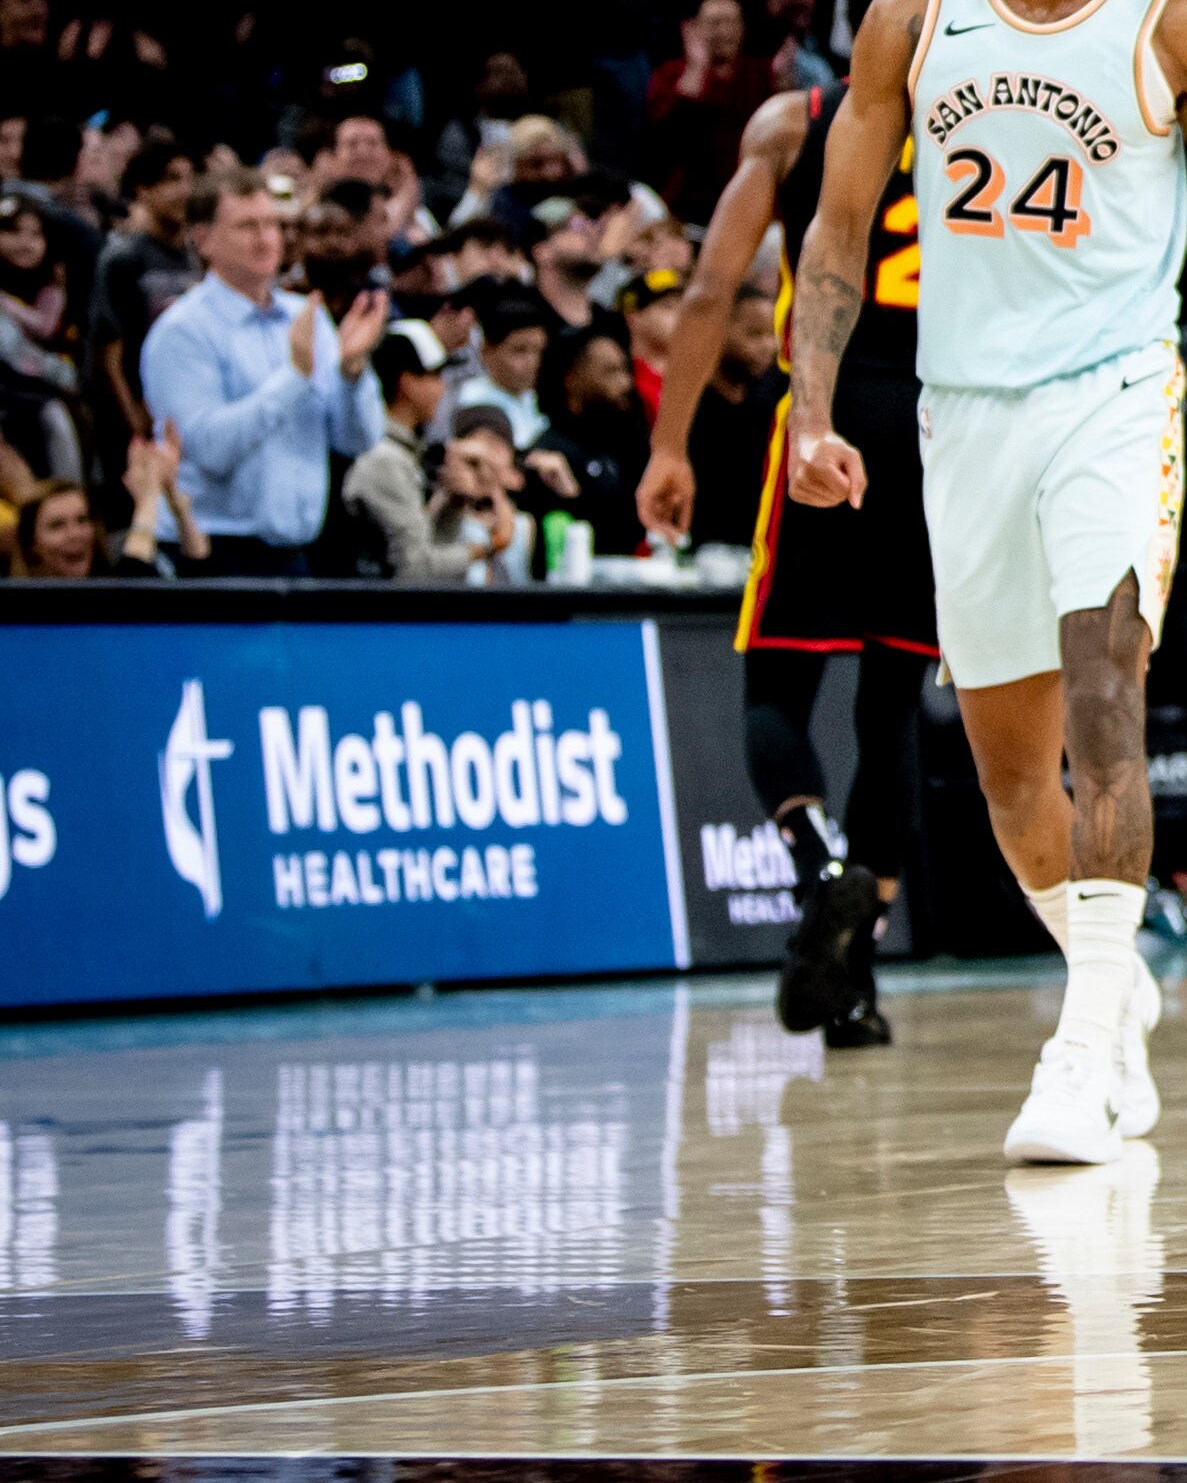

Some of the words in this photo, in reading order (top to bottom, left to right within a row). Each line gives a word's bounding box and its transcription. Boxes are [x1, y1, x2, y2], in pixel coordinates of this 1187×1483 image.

[926, 82, 985, 145] SAN
[990, 74, 1119, 163] ANTONIO
[944, 147, 1085, 240] 24
[259, 698, 629, 836] Methodist
[0, 767, 58, 901] s
[273, 842, 539, 910] HEALTHCARE
